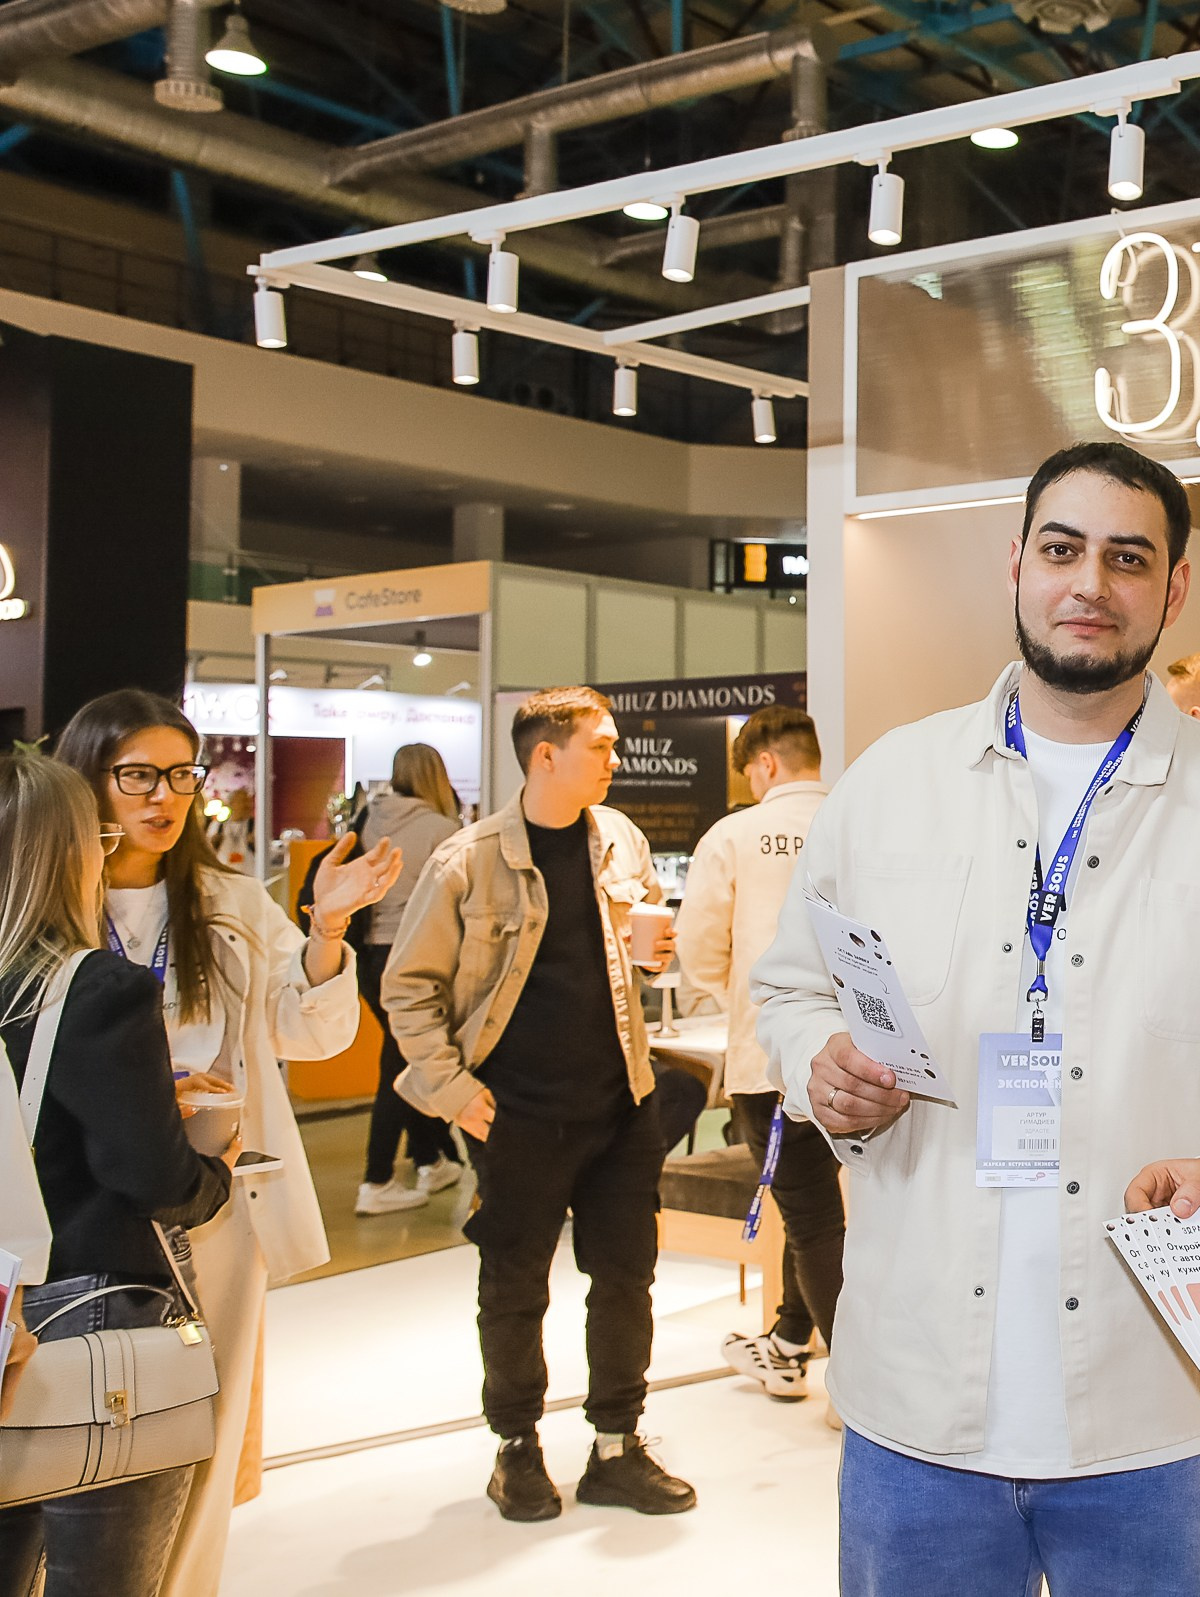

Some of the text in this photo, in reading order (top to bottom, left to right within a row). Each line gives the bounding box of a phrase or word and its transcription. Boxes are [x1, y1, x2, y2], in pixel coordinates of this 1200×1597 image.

[346, 588, 421, 609] CafeStore
[609, 684, 776, 712] MIUZ DIAMONDS
[624, 736, 673, 757] MIUZ
